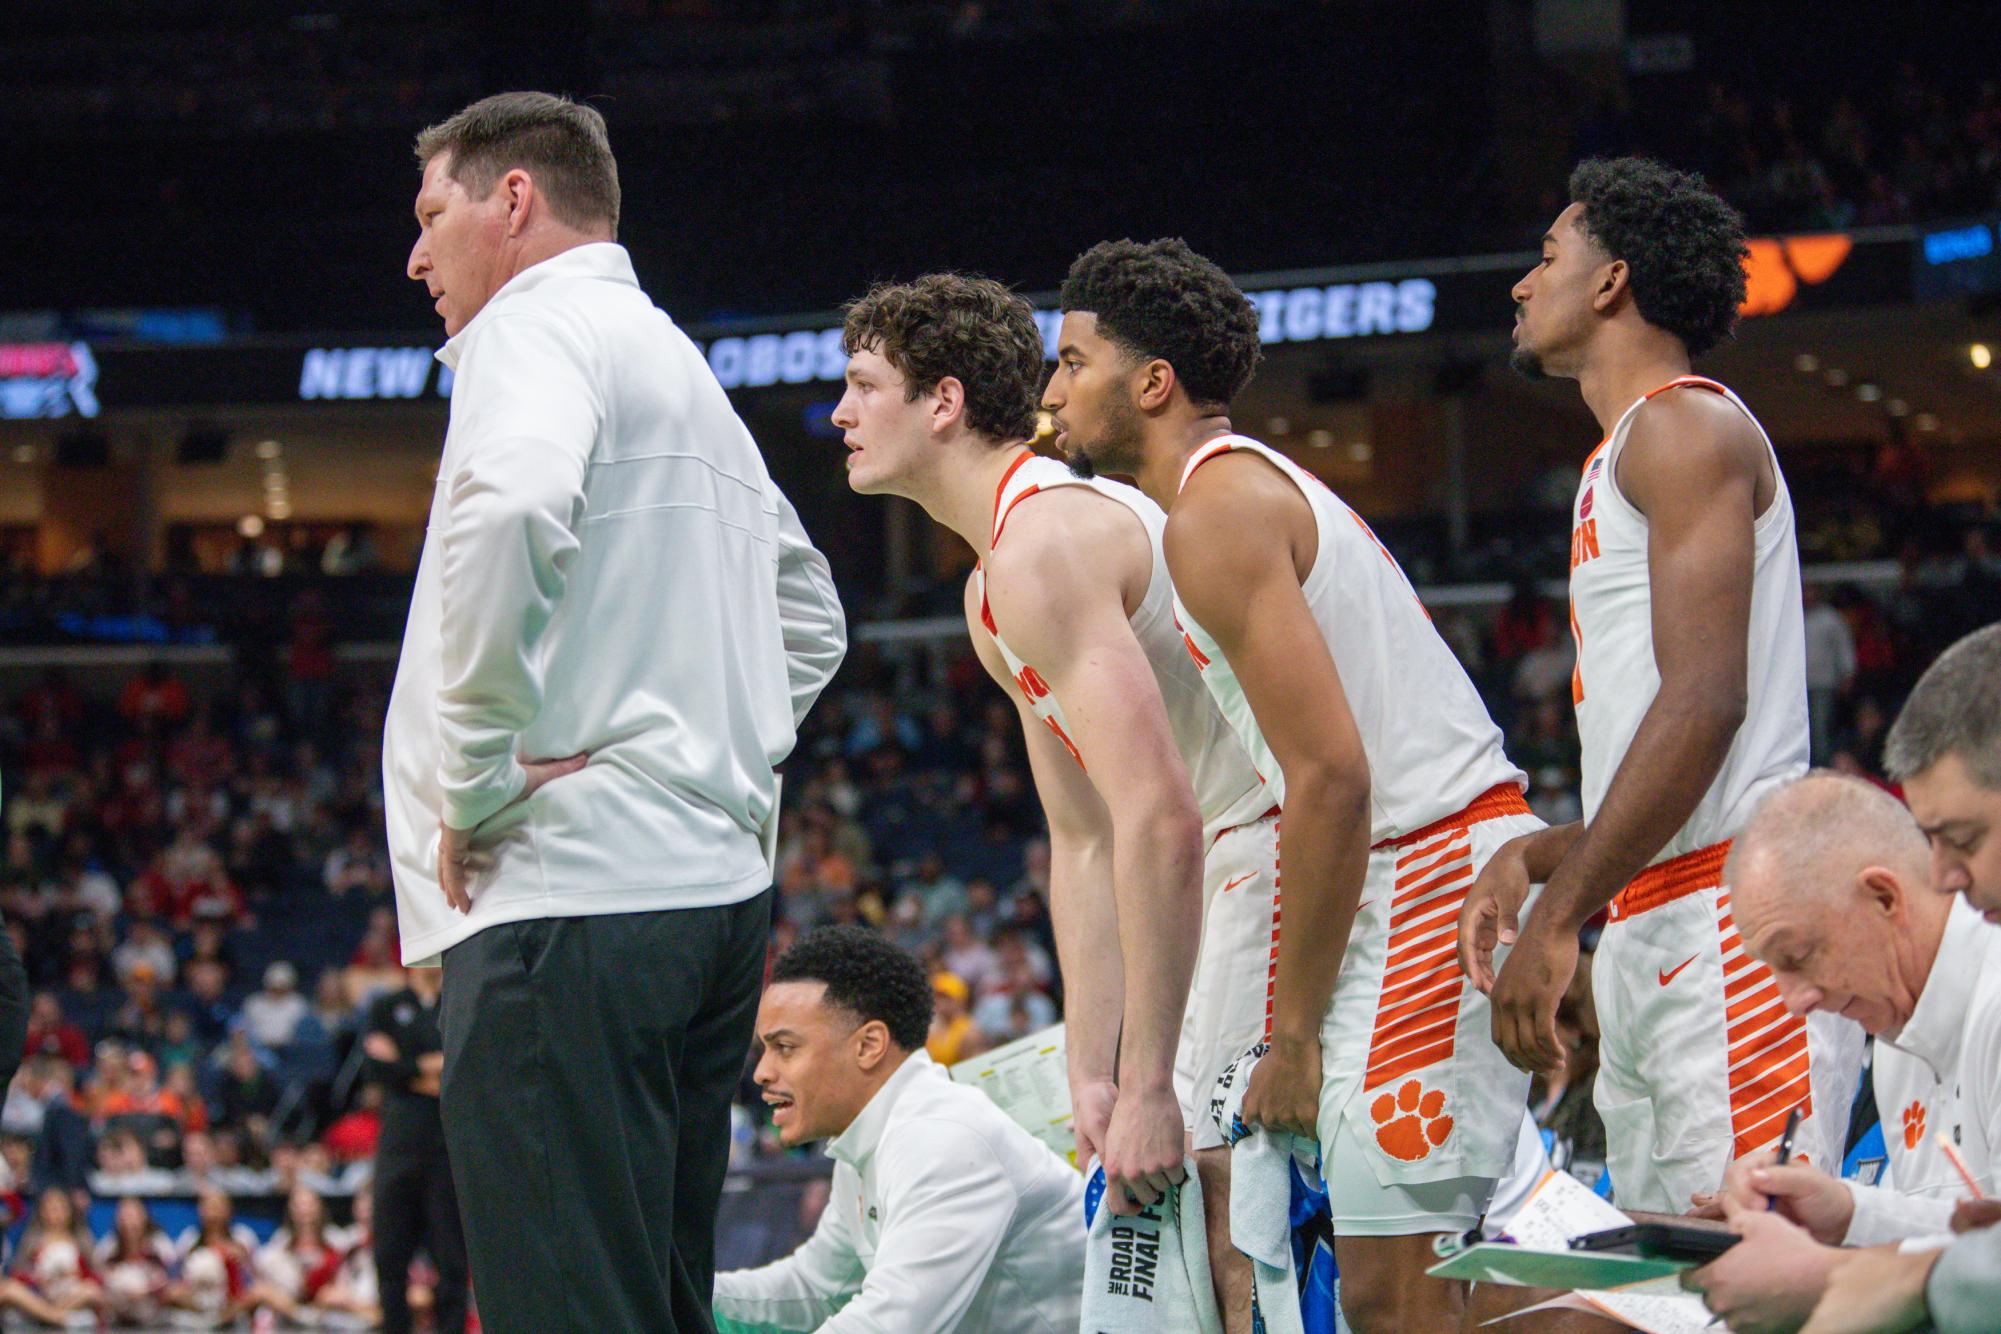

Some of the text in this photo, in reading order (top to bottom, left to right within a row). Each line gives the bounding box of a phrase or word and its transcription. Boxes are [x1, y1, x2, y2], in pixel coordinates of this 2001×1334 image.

[299, 347, 434, 399] NEW
[693, 328, 847, 389] OBOS
[1243, 278, 1437, 344] IGERS
[1570, 518, 1601, 572] ON
[1110, 1226, 1135, 1282] ROAD
[1132, 1230, 1161, 1302] FINAL
[1108, 1281, 1129, 1296] THE
